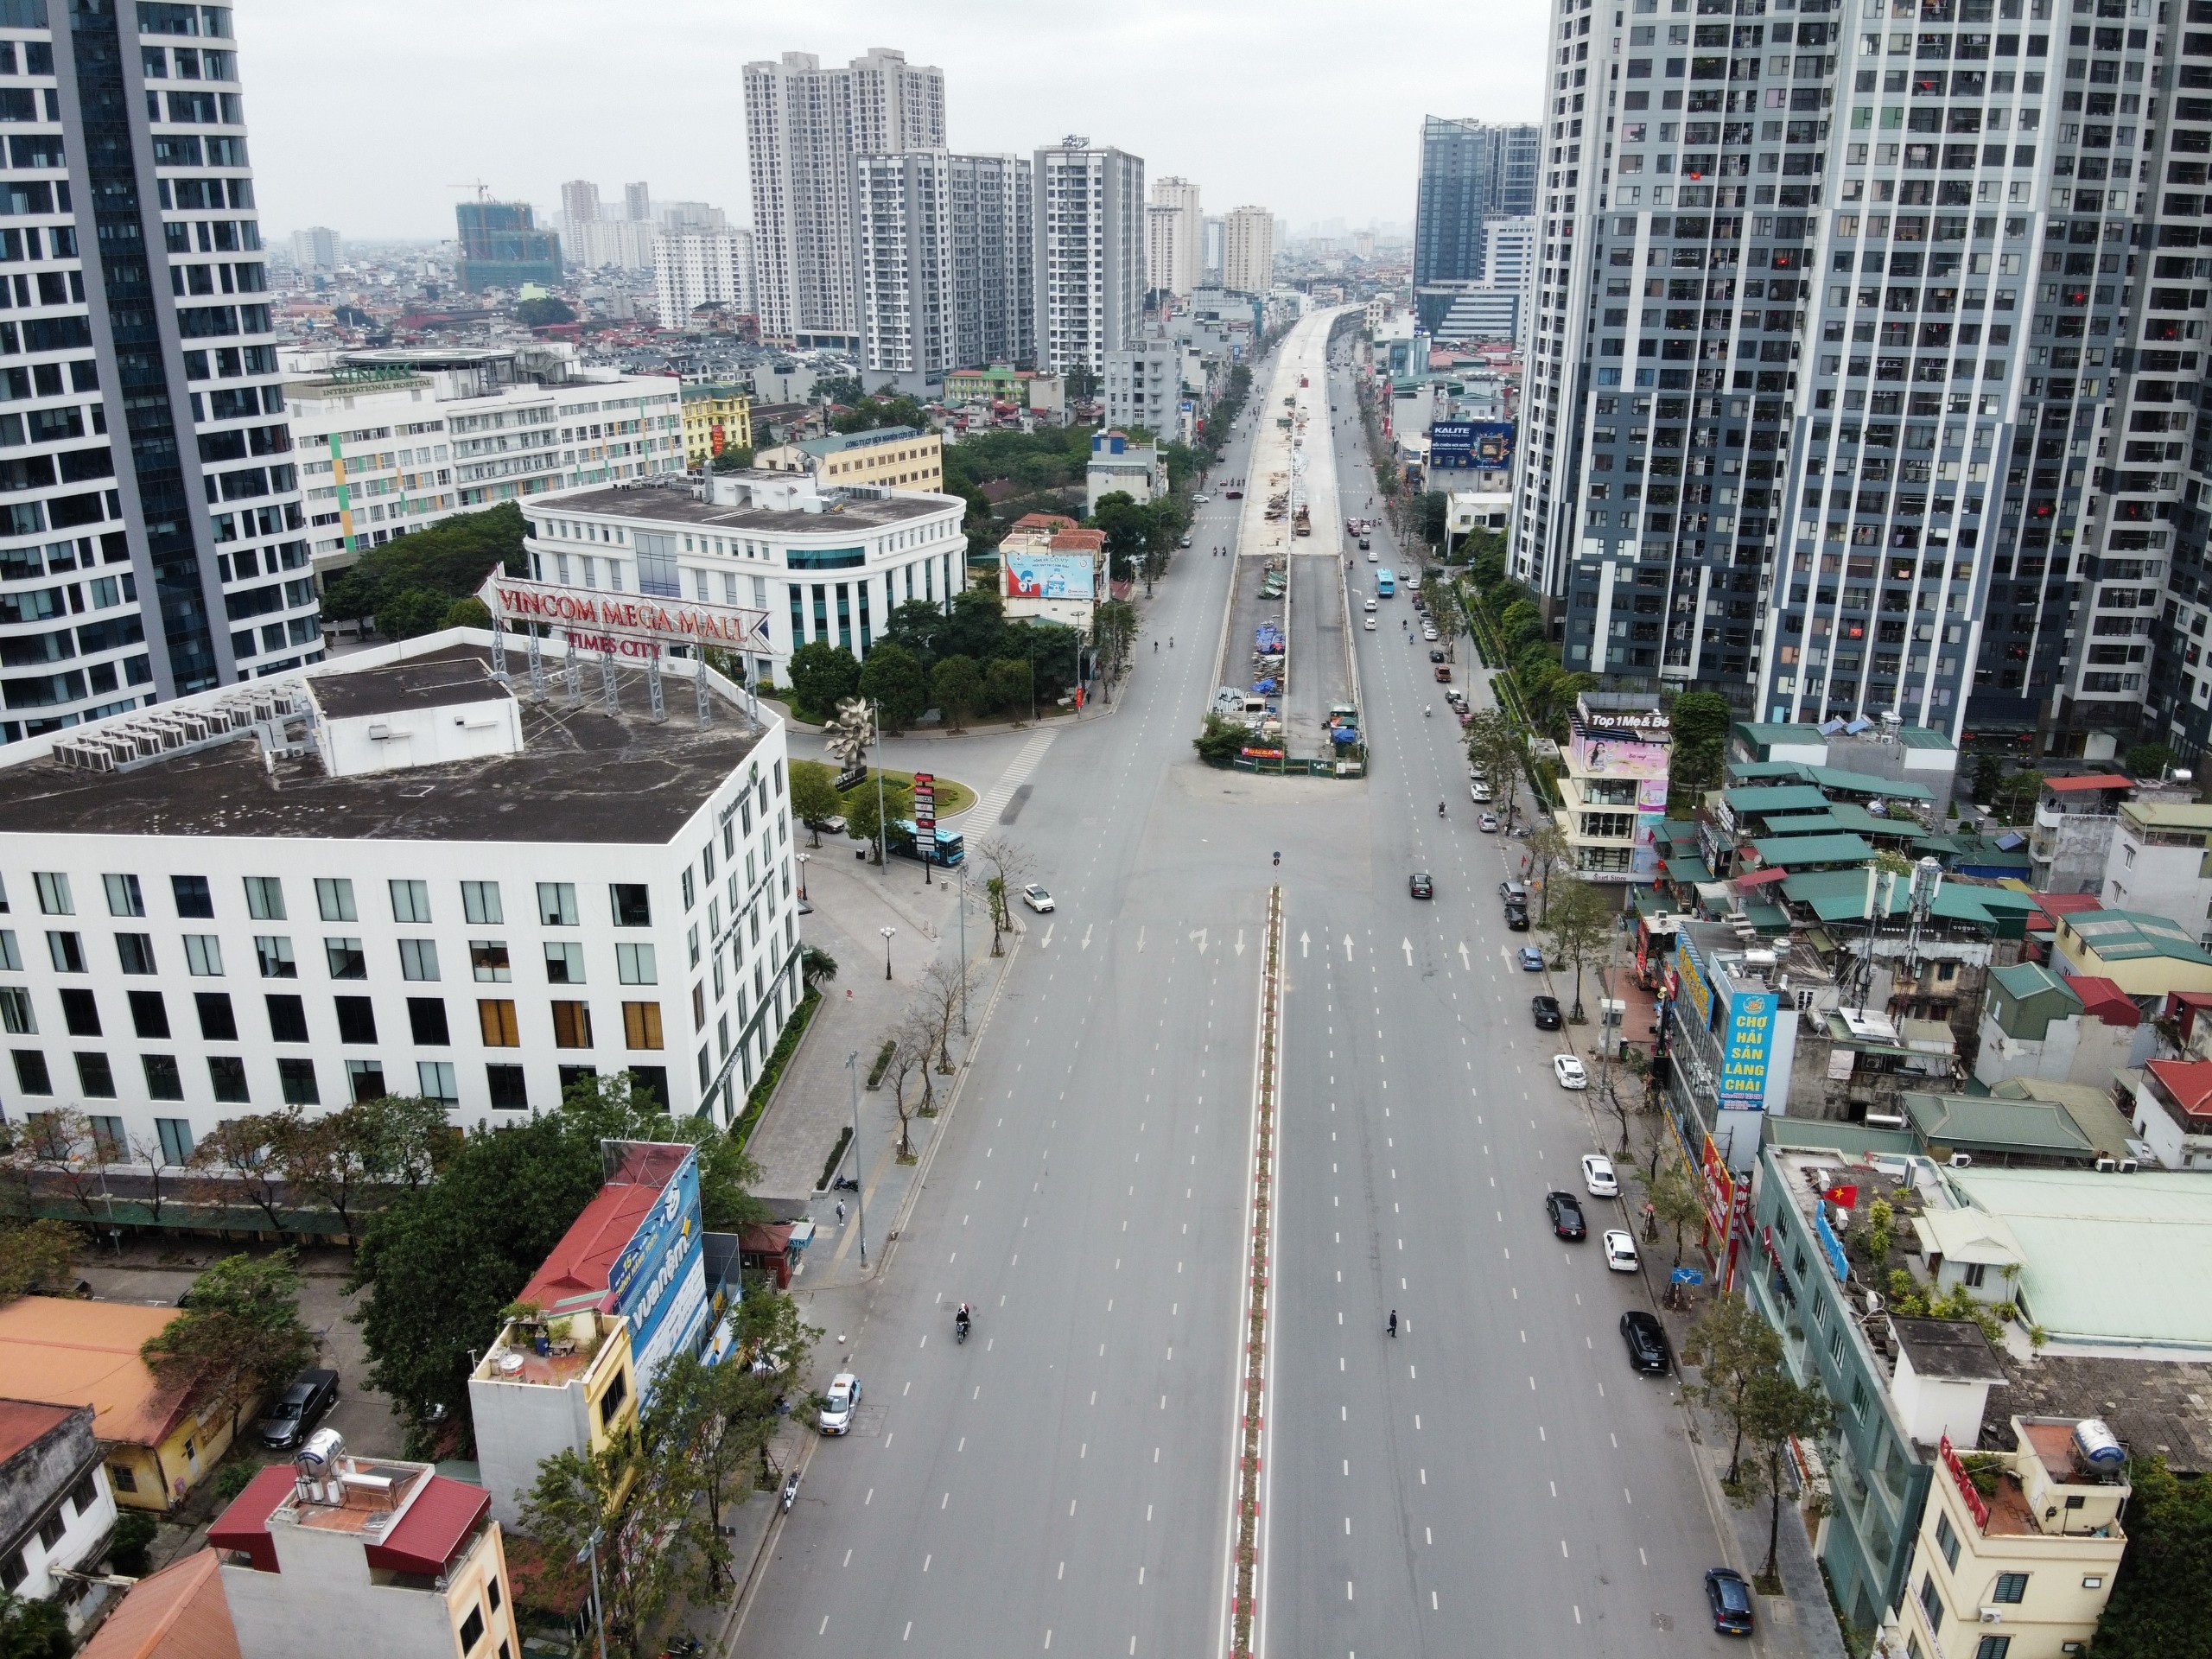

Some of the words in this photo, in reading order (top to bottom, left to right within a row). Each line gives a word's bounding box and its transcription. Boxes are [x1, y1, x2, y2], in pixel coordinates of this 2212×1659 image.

[322, 385, 391, 396] INTERNATIONAL
[392, 378, 432, 390] HOSPITAL
[499, 588, 596, 622] VINCOM
[602, 601, 674, 632] MEGA
[678, 610, 748, 642] MALL
[566, 632, 617, 654] TIMES
[619, 639, 663, 660] CITY
[1592, 715, 1614, 728] Top
[1652, 716, 1670, 728] Bé
[1737, 1016, 1768, 1030] CHỢ
[1736, 1028, 1763, 1044] HẢI
[1731, 1045, 1764, 1059] SẢN
[1725, 1061, 1764, 1076] LÀNG
[1725, 1077, 1761, 1091] CHÀI
[622, 1254, 632, 1274] 15
